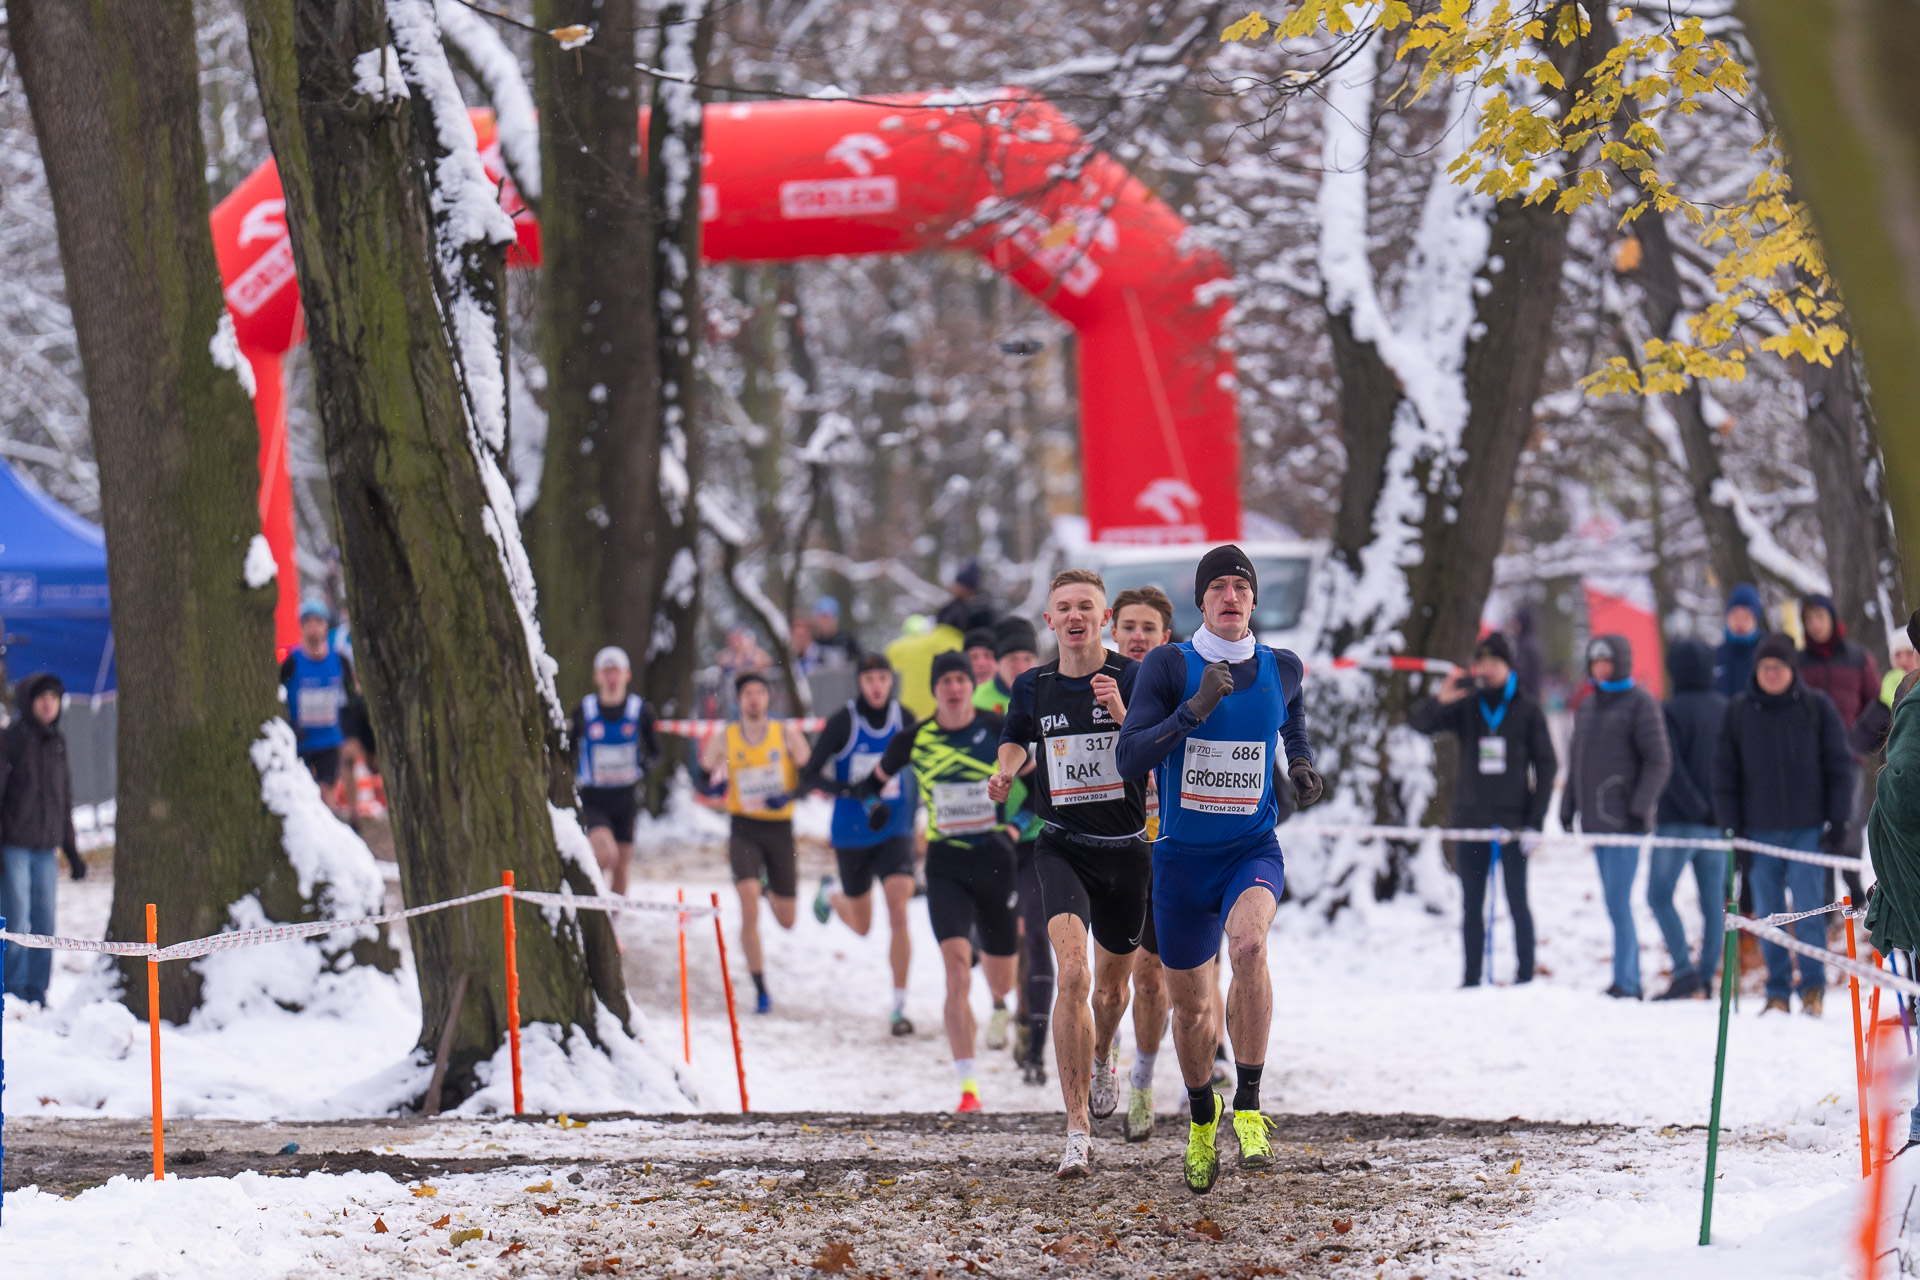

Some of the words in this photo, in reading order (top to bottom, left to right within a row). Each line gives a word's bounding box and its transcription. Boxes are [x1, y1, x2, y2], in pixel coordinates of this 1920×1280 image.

[1085, 736, 1114, 751] 317
[1197, 745, 1211, 755] 770
[1231, 746, 1260, 760] 686
[1066, 761, 1102, 780] RAK
[1199, 804, 1226, 812] BYTOM
[1227, 805, 1245, 813] 2024
